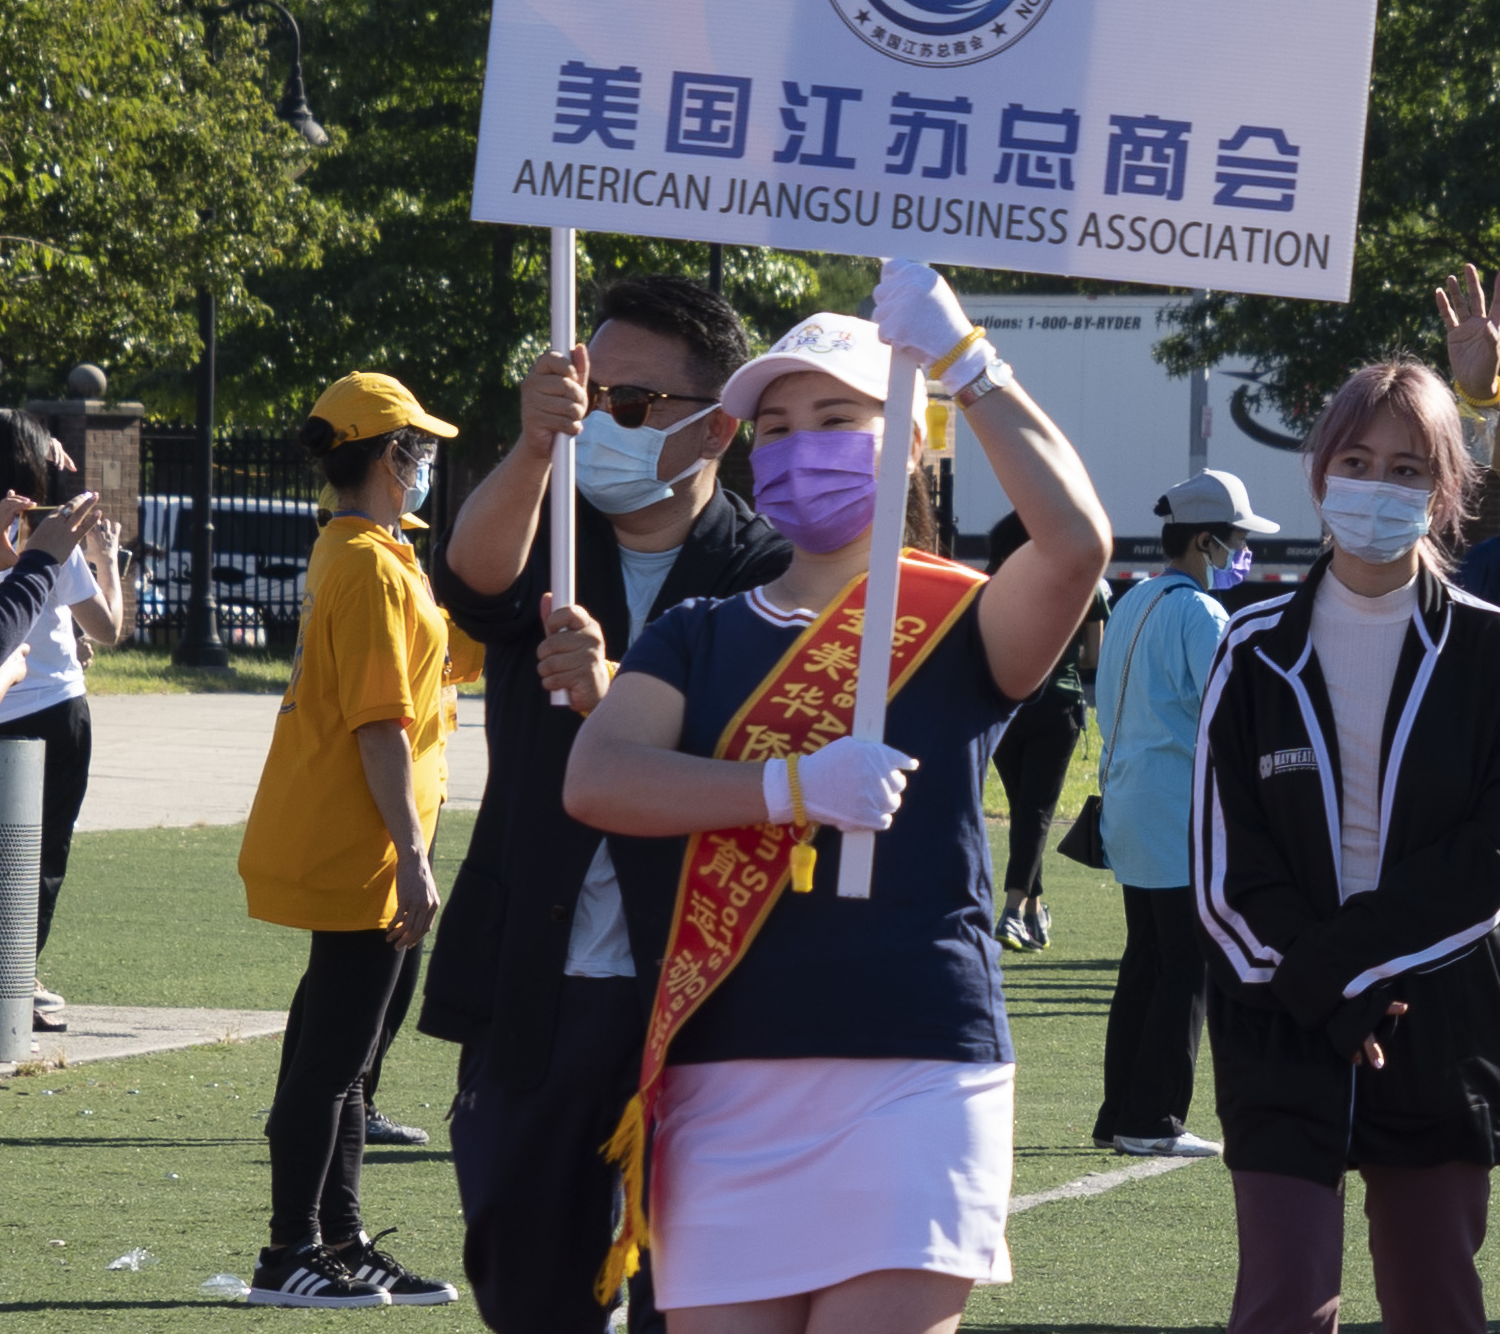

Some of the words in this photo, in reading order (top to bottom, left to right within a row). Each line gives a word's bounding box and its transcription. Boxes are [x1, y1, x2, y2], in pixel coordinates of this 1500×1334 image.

[870, 25, 984, 58] 美国江苏总商会
[552, 60, 1300, 212] 美国江苏总商会
[512, 159, 711, 212] AMERICAN
[719, 177, 881, 227] JIANGSU
[890, 193, 1069, 245] BUSINESS
[1077, 212, 1331, 270] ASSOCIATION
[970, 315, 1023, 330] vations:
[1027, 316, 1142, 330] 1-800-BY-RYDER
[707, 863, 769, 971] Sports
